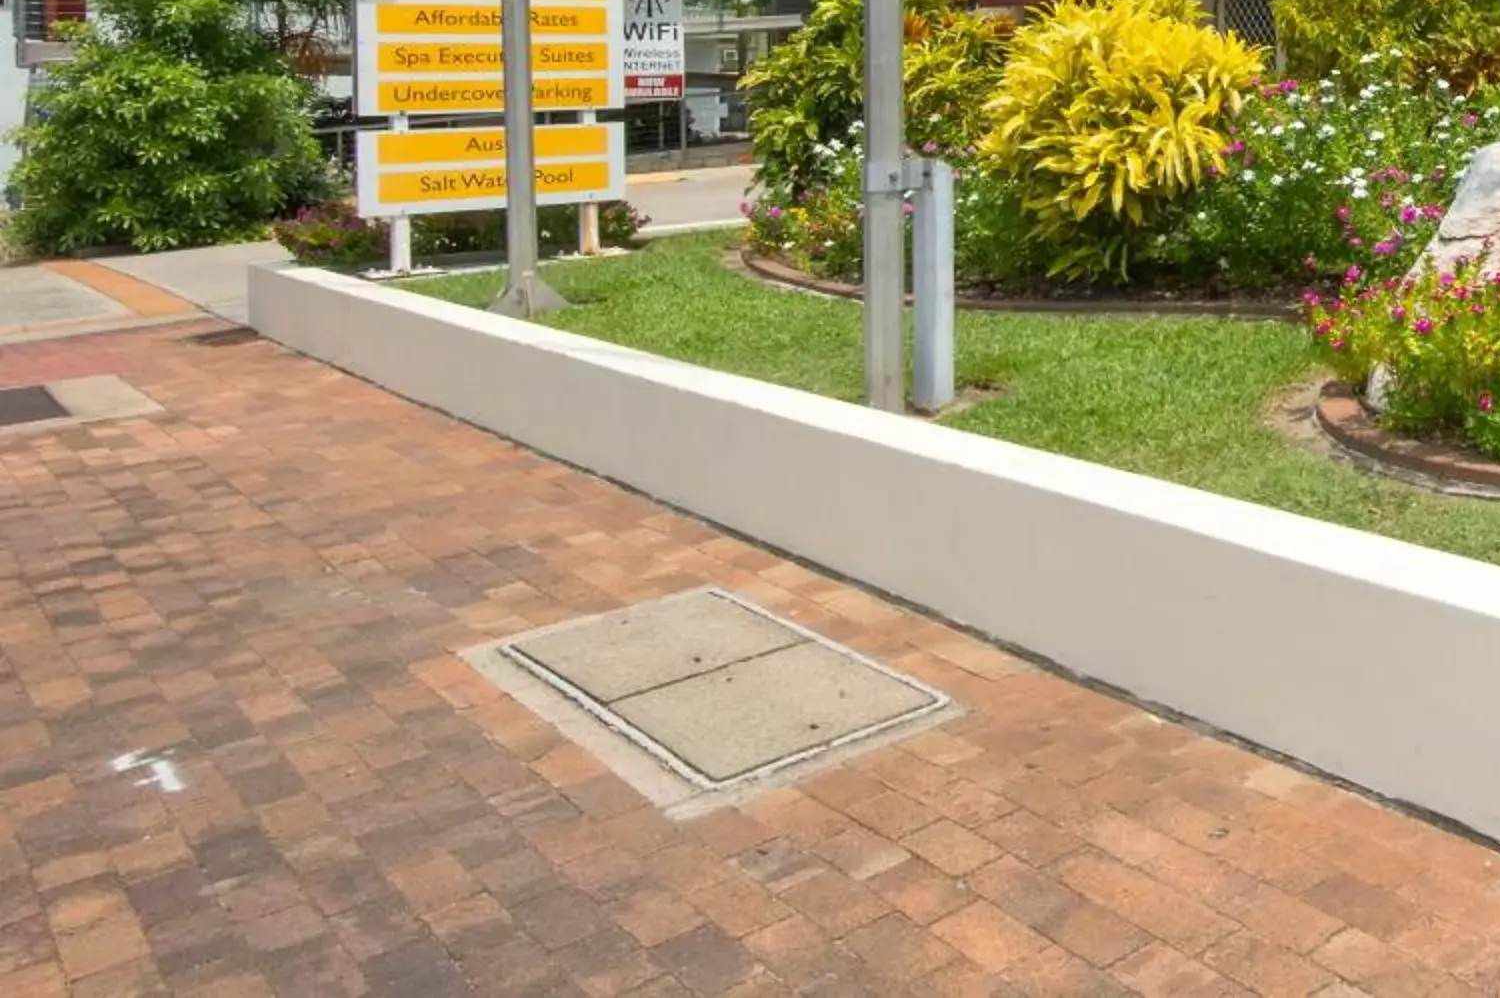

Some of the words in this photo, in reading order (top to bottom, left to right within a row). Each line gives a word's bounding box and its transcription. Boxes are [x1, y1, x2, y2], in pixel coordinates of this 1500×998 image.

[414, 9, 504, 27] Affordab
[624, 22, 679, 41] WiFi
[395, 47, 431, 68] Spa
[540, 48, 596, 63] Suites
[532, 83, 593, 103] arking
[420, 176, 455, 193] Salt
